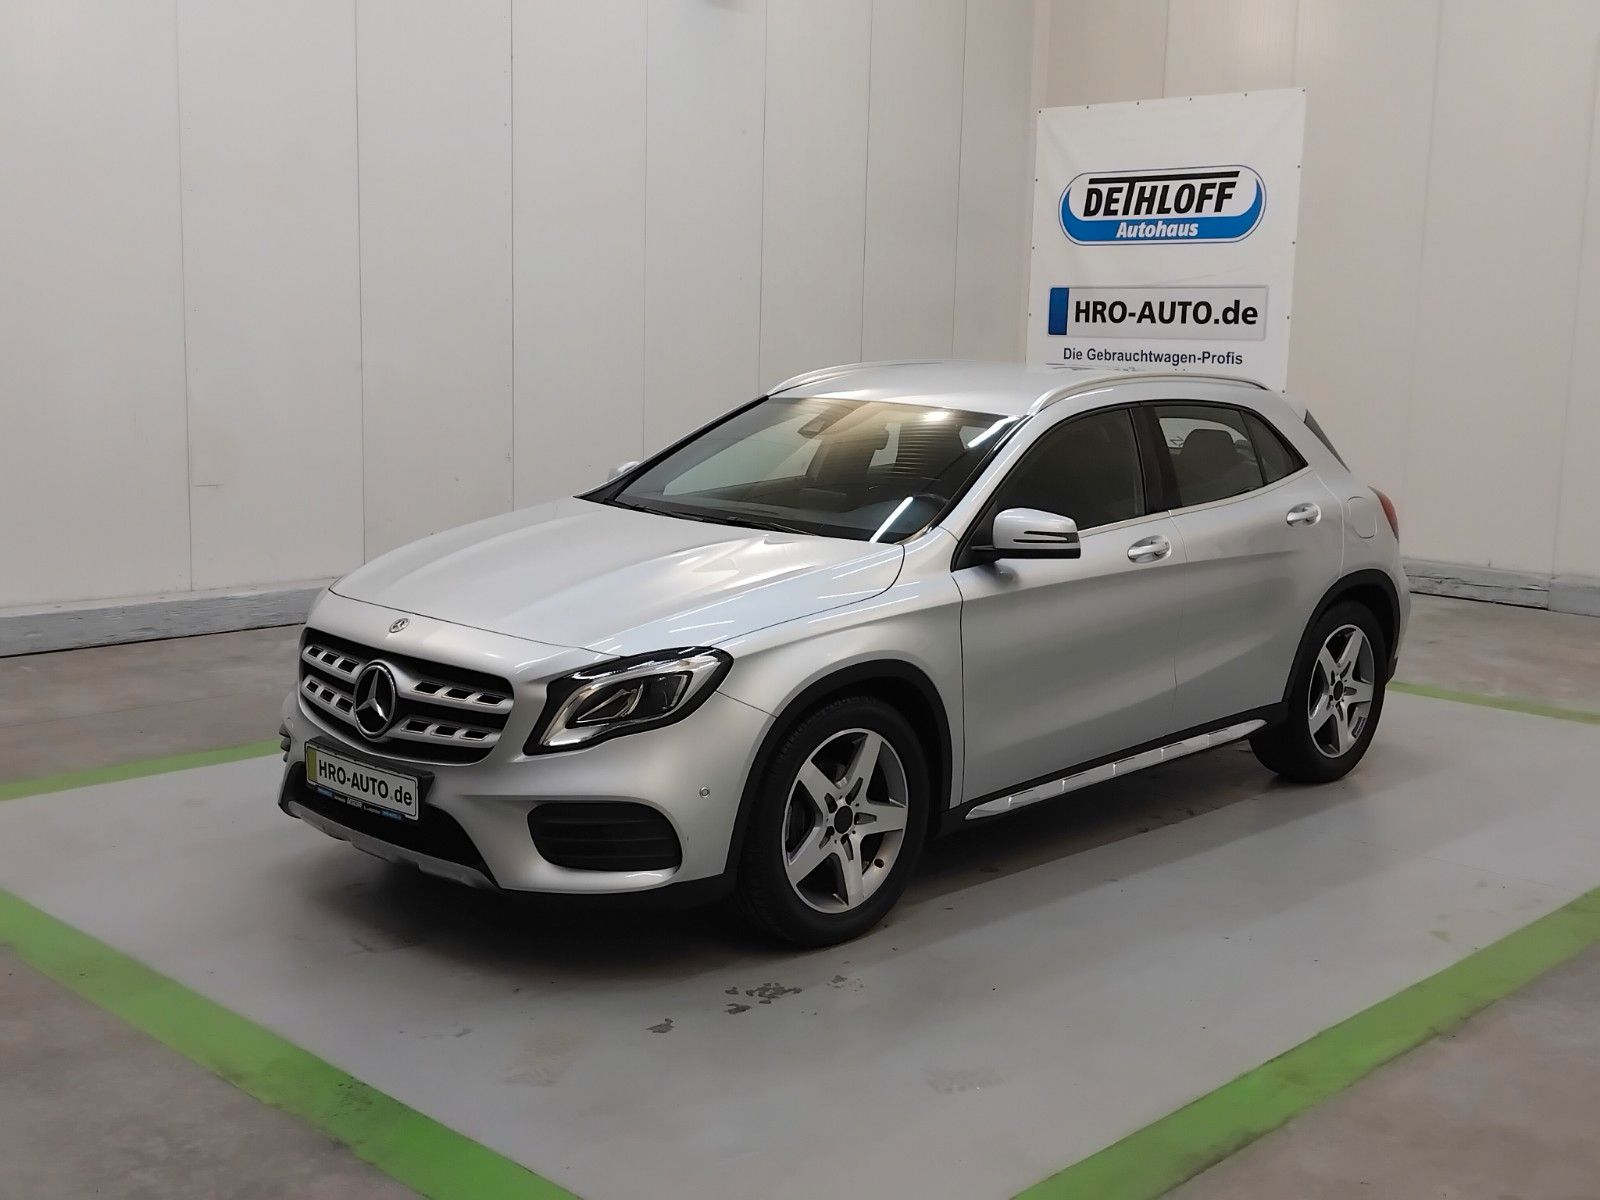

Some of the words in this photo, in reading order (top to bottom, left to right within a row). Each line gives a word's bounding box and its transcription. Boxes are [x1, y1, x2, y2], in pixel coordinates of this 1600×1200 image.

[1083, 170, 1240, 217] DETHLOFF
[1116, 221, 1198, 238] Autohaus
[1075, 300, 1258, 325] HRO-AUTO.de
[1063, 348, 1083, 360] Die
[1086, 348, 1243, 366] Gebrauchtwagen-Profis
